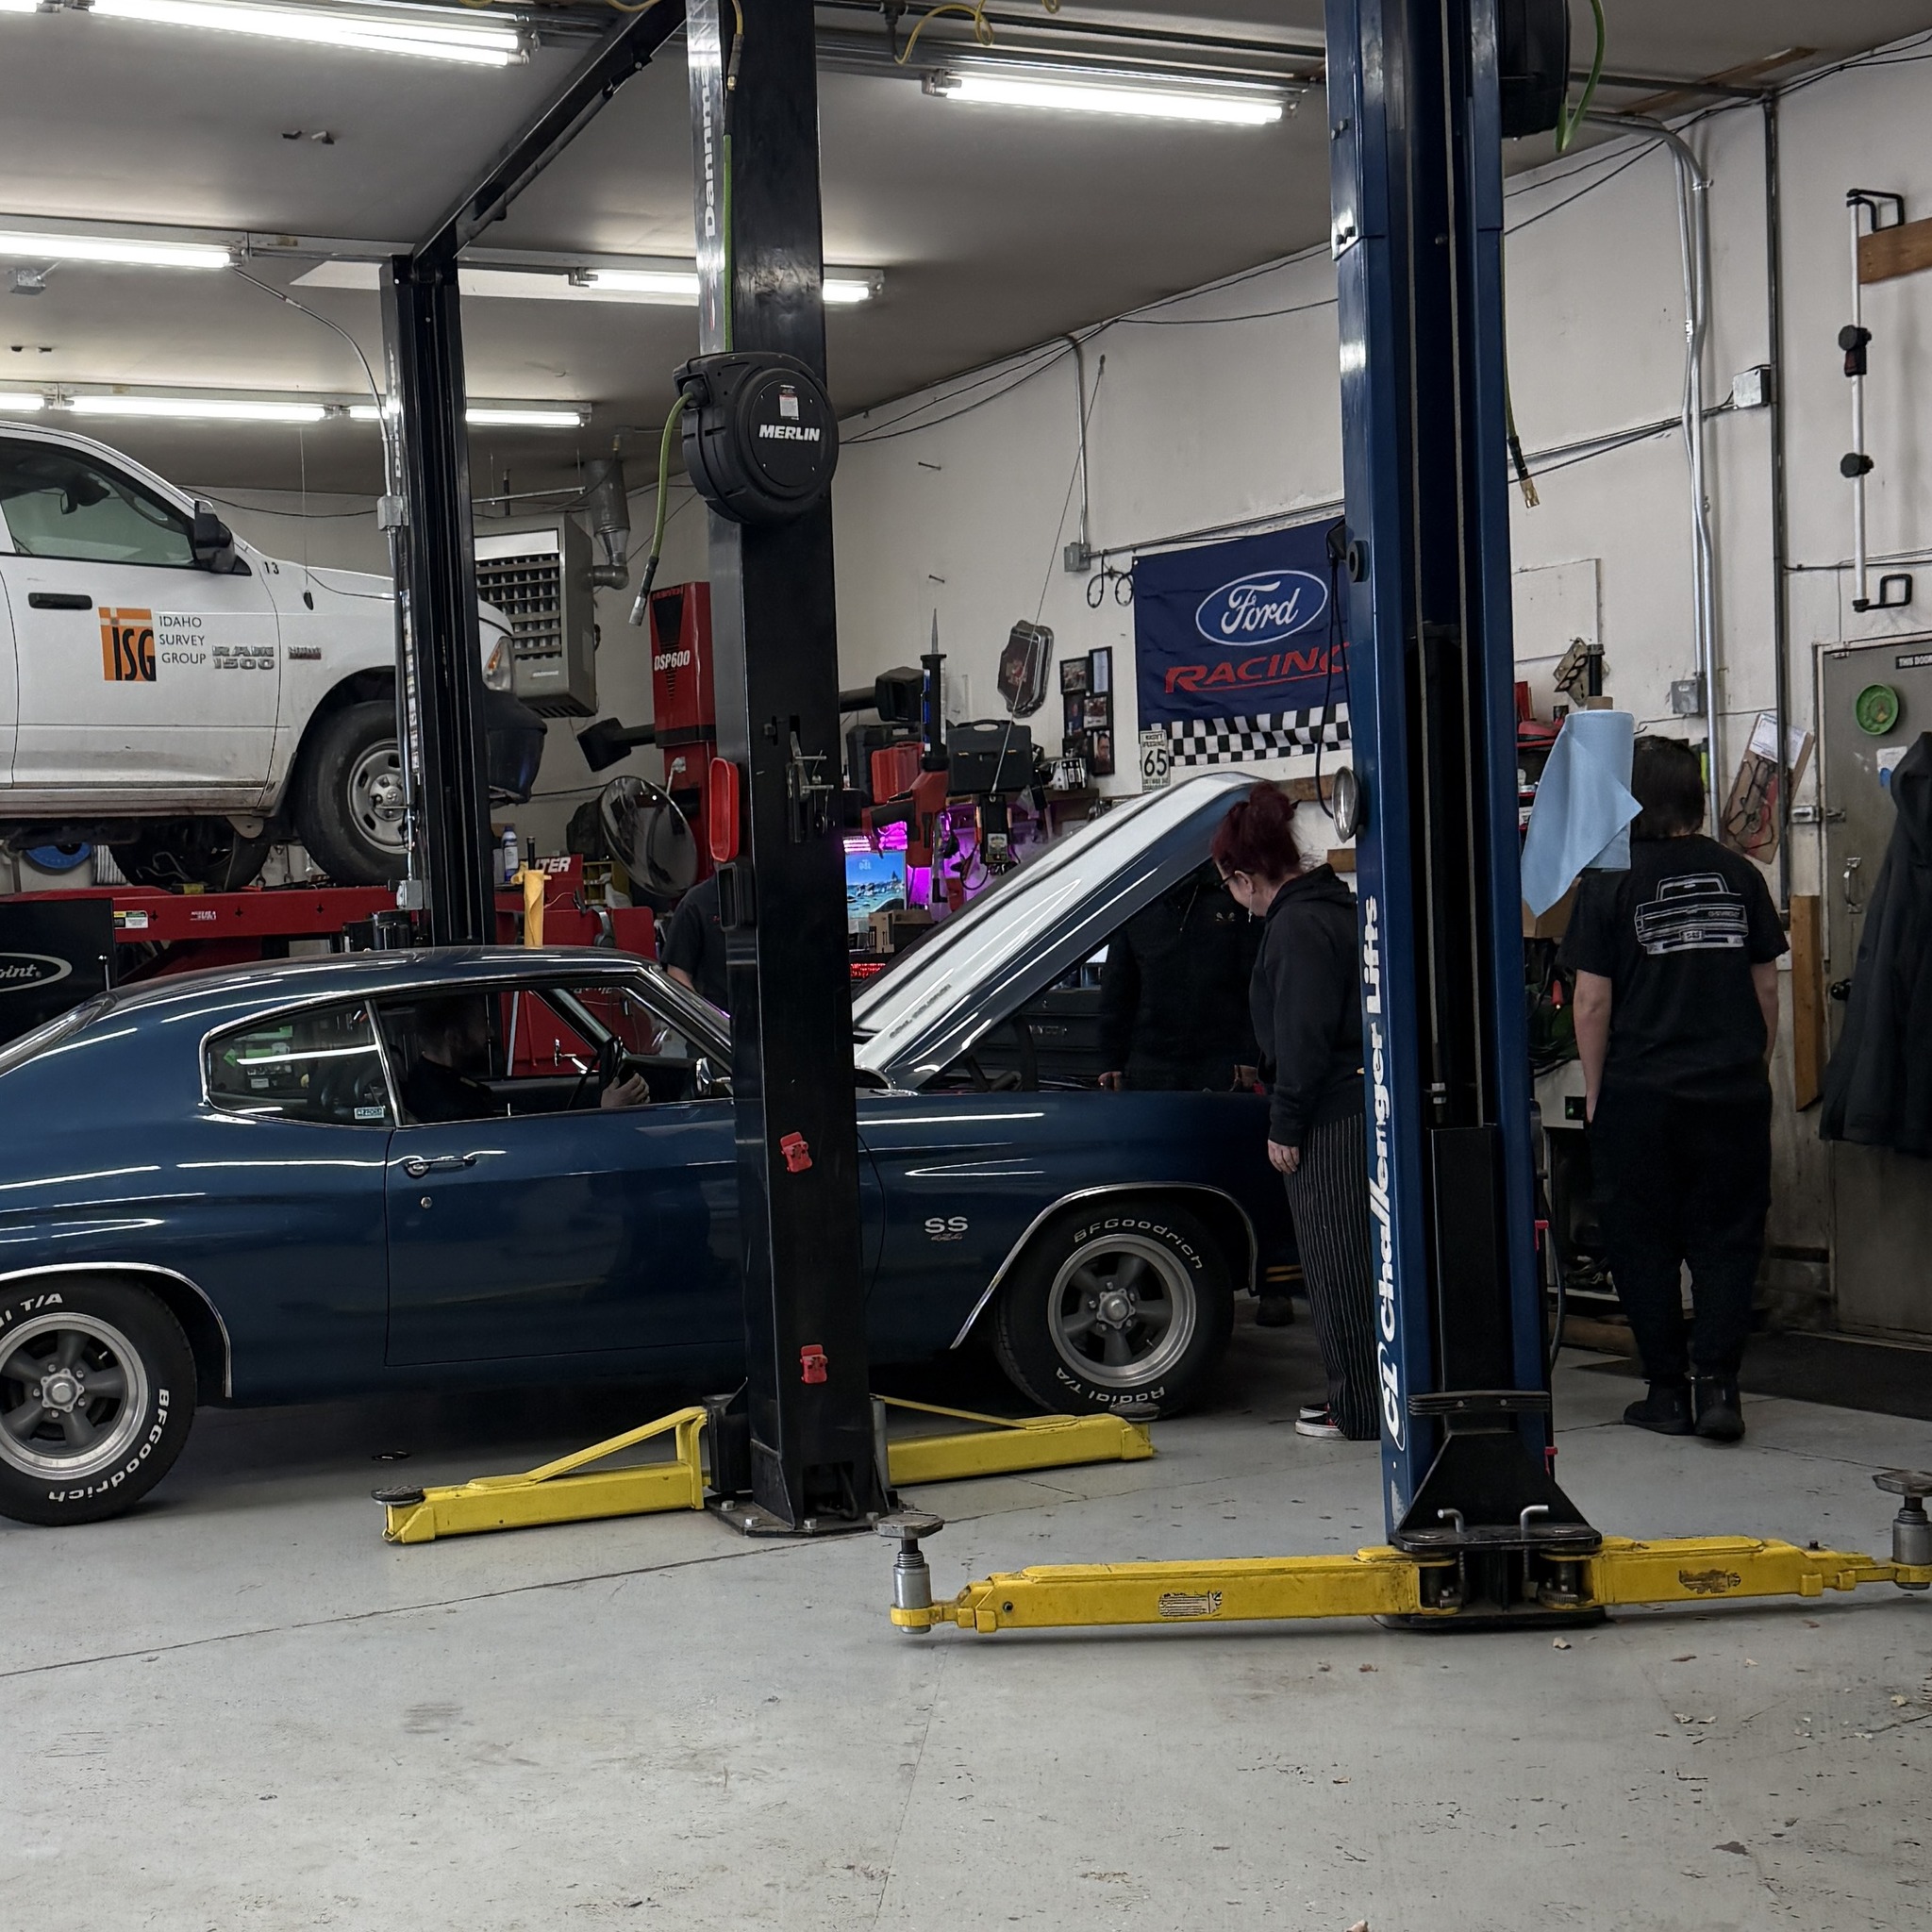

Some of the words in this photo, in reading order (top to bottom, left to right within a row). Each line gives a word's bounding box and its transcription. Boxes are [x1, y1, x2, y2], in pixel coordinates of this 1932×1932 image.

[758, 425, 820, 441] MERLIN
[263, 561, 280, 575] 13
[1221, 581, 1301, 634] Ford
[158, 615, 202, 628] IDAHO
[158, 633, 206, 647] SURVEY
[111, 626, 157, 681] ISG
[161, 652, 207, 665] GROUP
[212, 644, 275, 658] RAM
[654, 650, 691, 671] DSP600
[212, 658, 275, 671] 1500
[1143, 748, 1167, 776] 65
[1363, 895, 1382, 1015] Lifts
[1370, 1022, 1396, 1342] Challenger
[924, 1216, 969, 1234] SS
[1074, 1218, 1203, 1269] BFGoodrich
[20, 1292, 63, 1311] T/A
[1056, 1367, 1083, 1394] T/A
[48, 1388, 171, 1503] BFGoodrich
